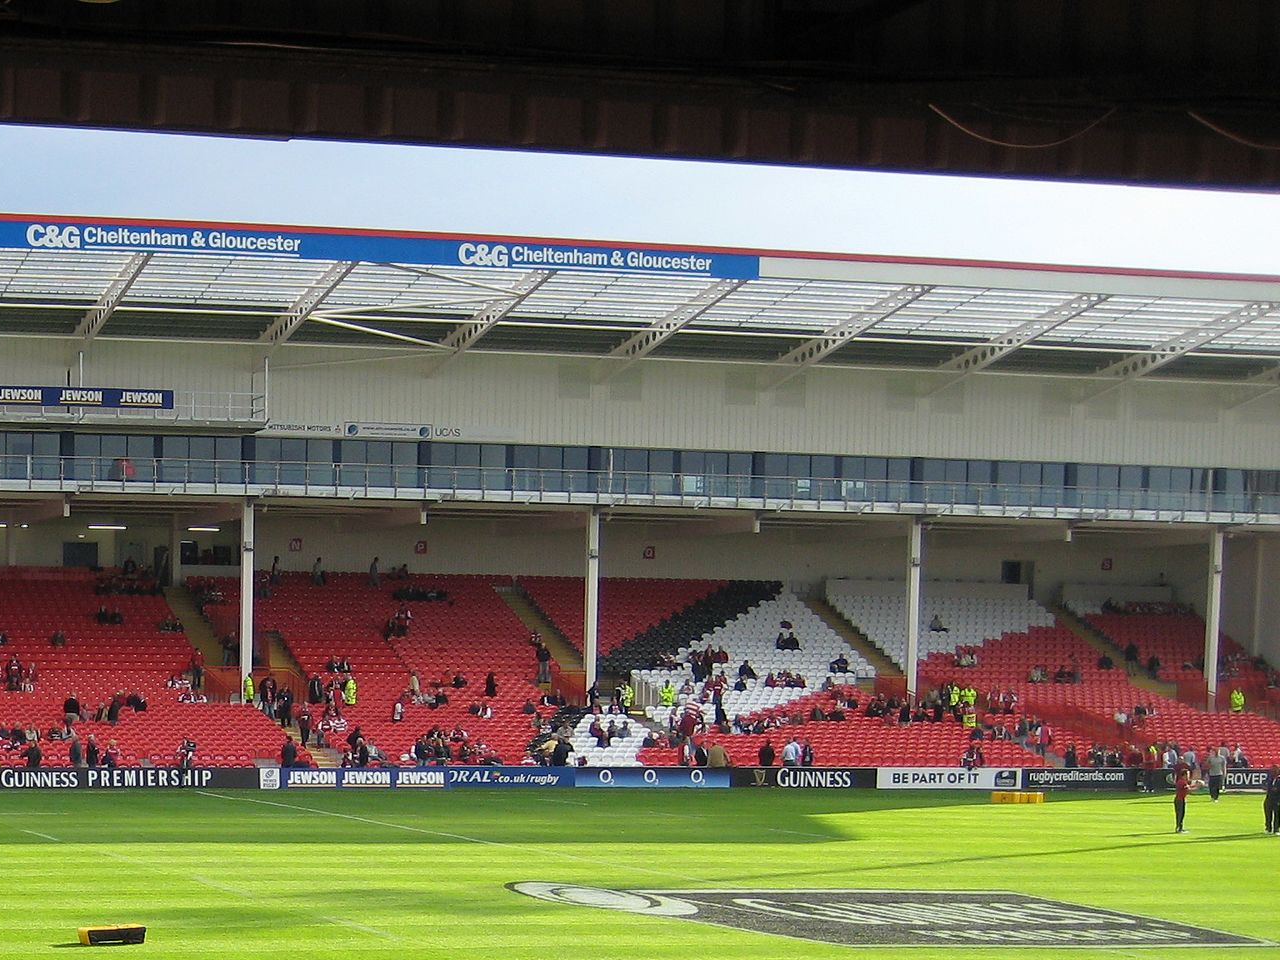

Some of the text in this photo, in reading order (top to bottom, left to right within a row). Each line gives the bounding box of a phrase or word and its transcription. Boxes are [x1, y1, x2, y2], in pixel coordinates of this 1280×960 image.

[26, 224, 300, 251] C&G Cheltenham & Gloucester
[458, 243, 712, 271] C&G Cheltenham & Gloucester
[0, 389, 41, 400] JEWSON
[60, 390, 102, 401] JEWSON
[120, 391, 162, 403] JEWSON
[0, 769, 212, 788] GUINNESS PREMIERSHIP
[288, 771, 336, 784] JEWSON
[342, 771, 390, 784] JEWSON
[396, 772, 444, 784] JEWSON
[776, 768, 851, 788] GUINNESS
[892, 773, 979, 784] BE PART OF IT
[1029, 771, 1124, 785] rugbycreditcards.com
[1227, 773, 1268, 785] ROVER
